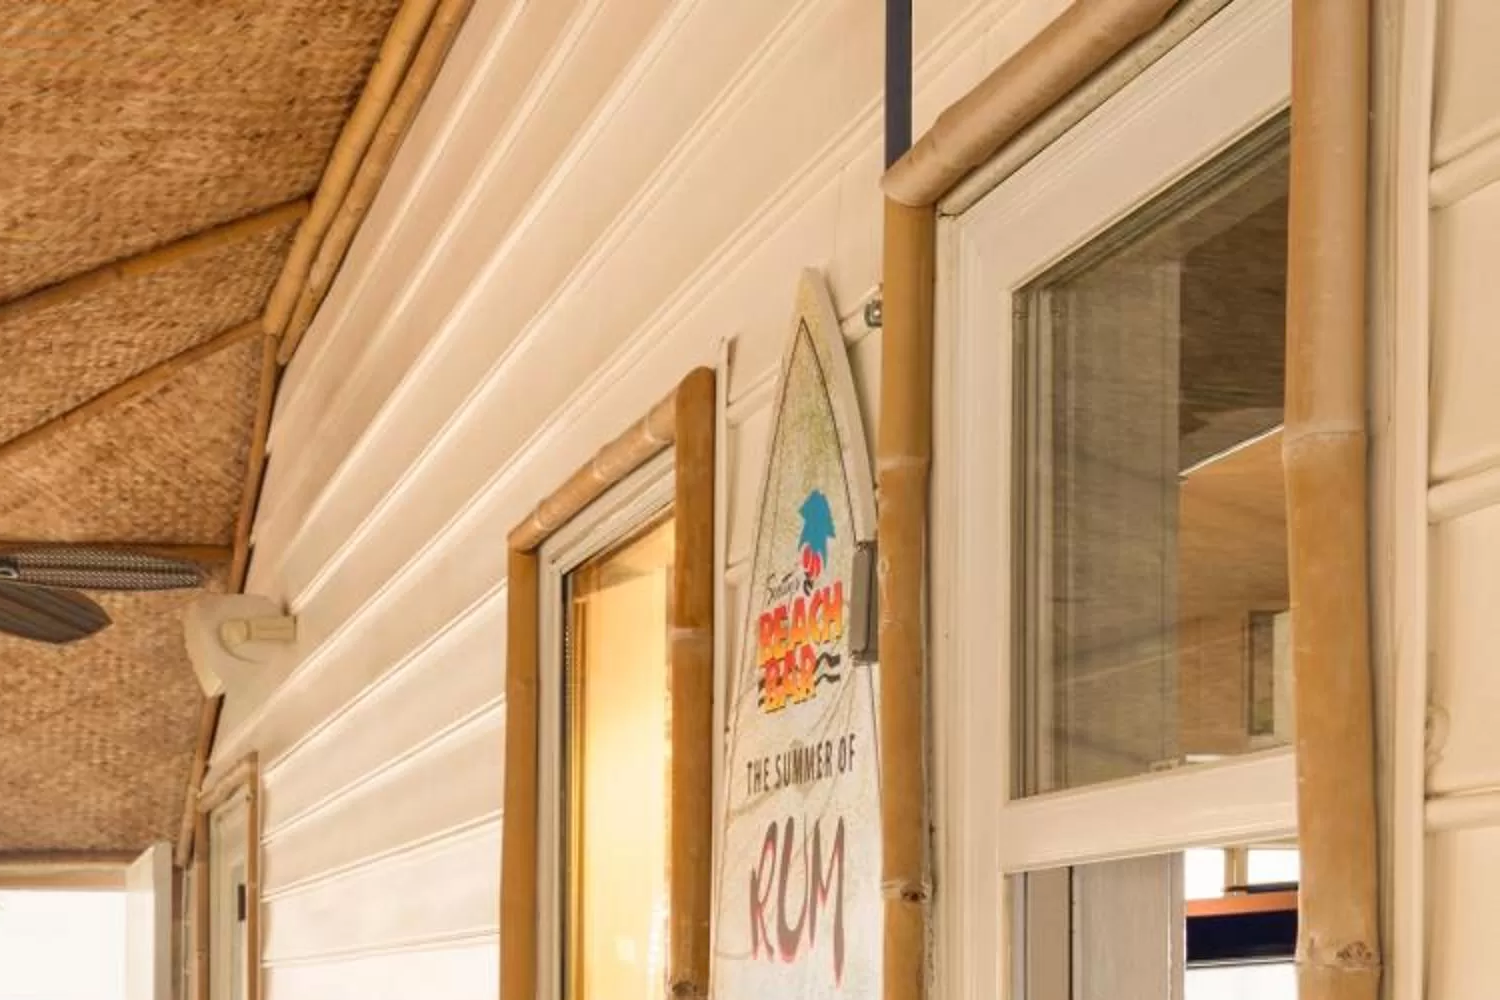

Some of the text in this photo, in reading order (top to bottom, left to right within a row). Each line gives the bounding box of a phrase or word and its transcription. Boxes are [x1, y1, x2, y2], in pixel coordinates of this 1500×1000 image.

[758, 578, 843, 668] BEACH
[763, 643, 817, 714] BAR
[746, 733, 856, 796] THE SUMMER OF
[750, 815, 846, 992] RUM
